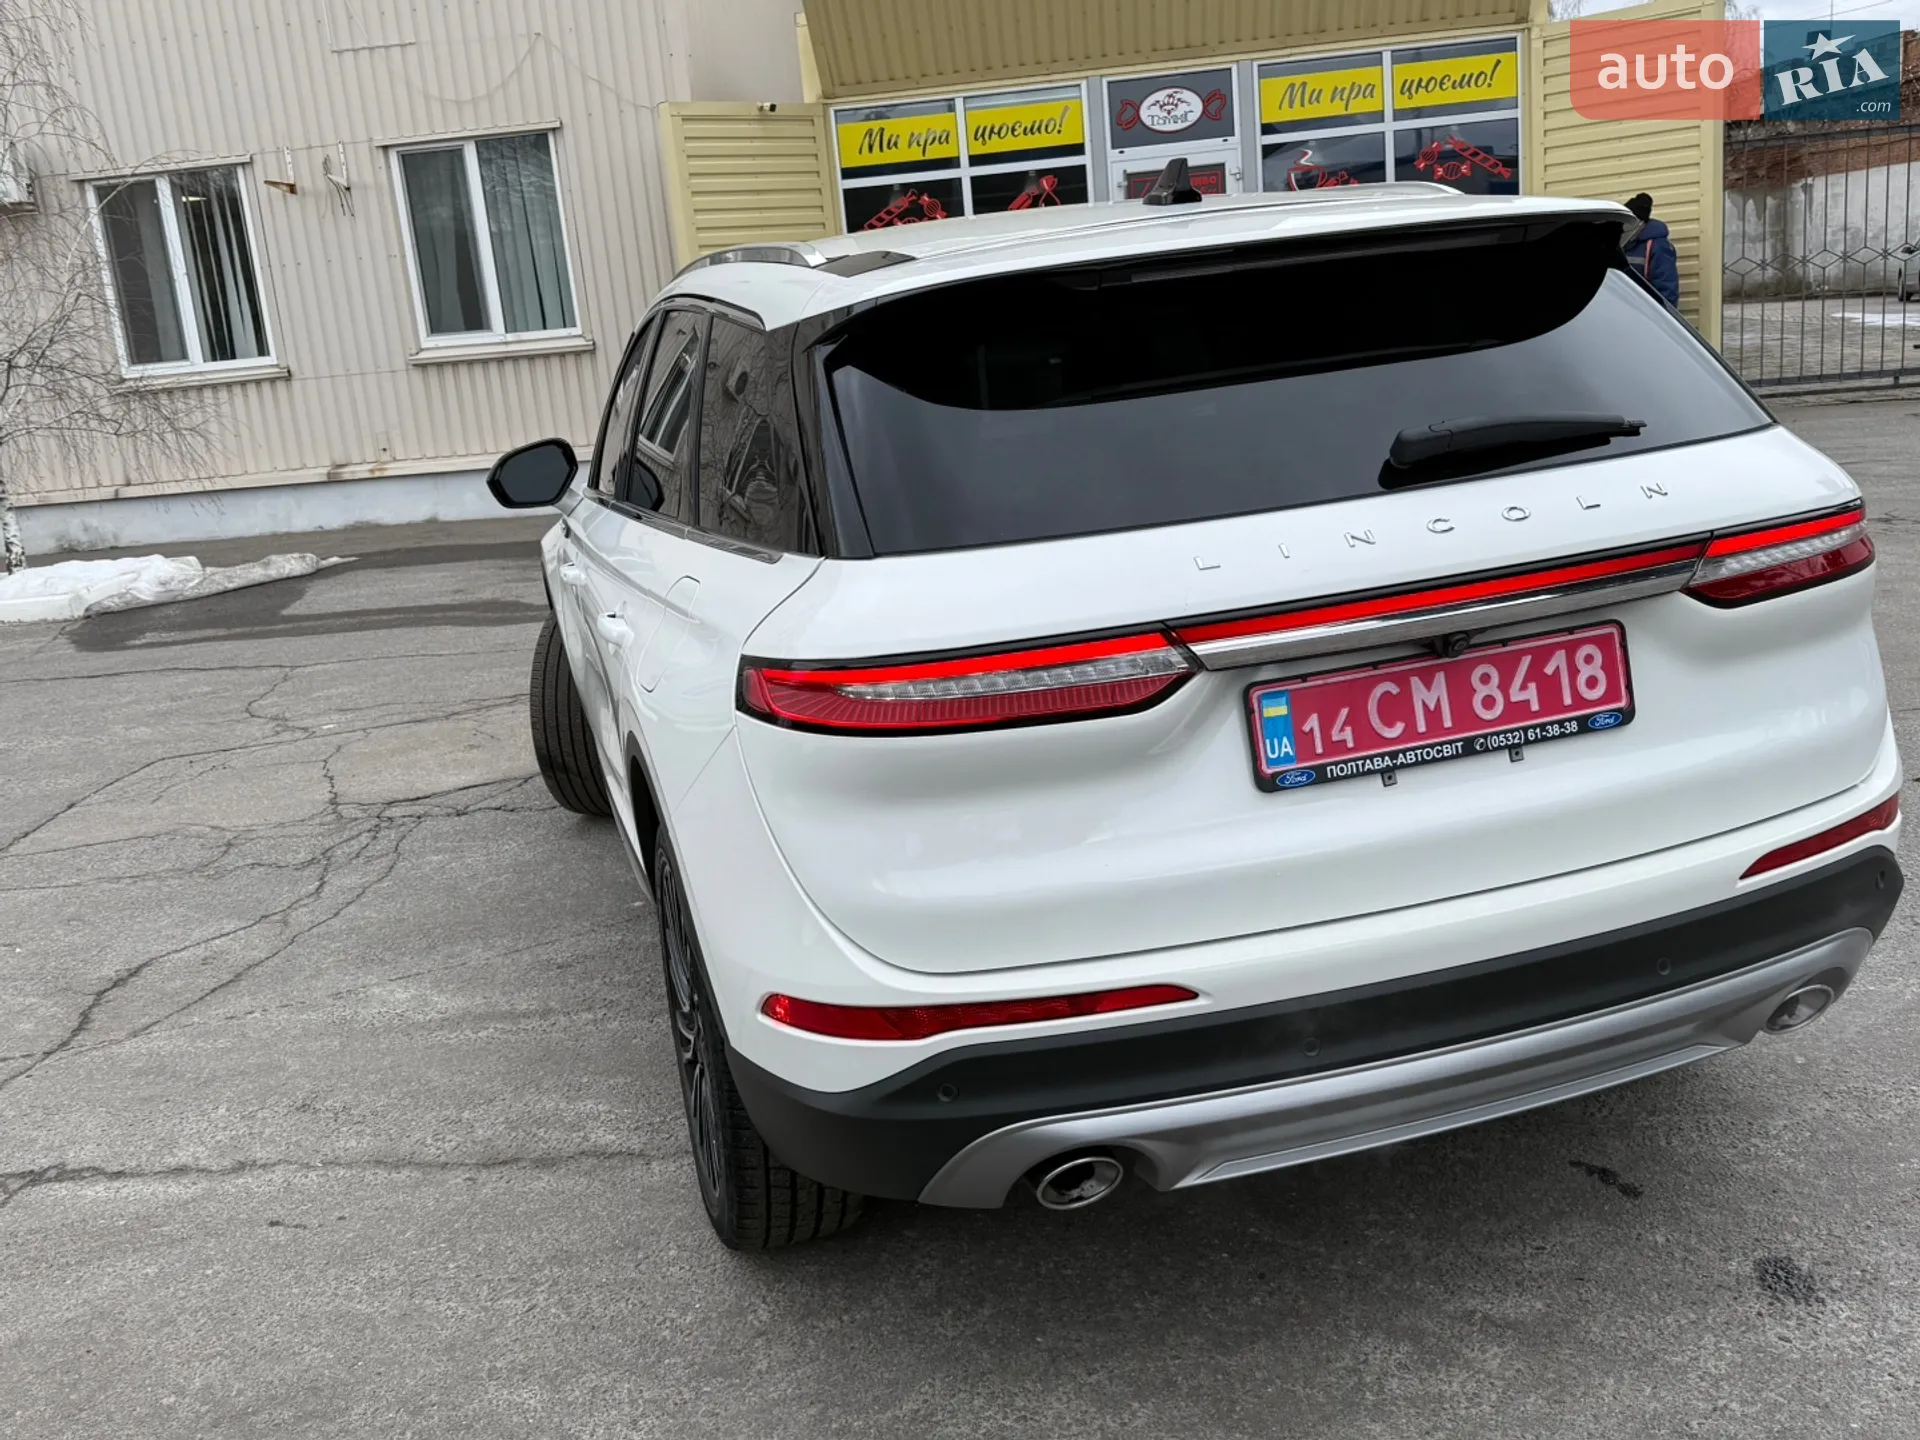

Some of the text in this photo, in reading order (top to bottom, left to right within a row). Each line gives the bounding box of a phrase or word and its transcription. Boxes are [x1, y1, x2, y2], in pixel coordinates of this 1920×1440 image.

[1279, 81, 1323, 111] Ми
[858, 127, 901, 156] Ми
[1194, 481, 1669, 571] LINCOLN
[1471, 644, 1608, 722] 8418
[1266, 735, 1294, 760] UA
[1326, 721, 1579, 778] ПОЛТАВА-АВТОСВІТ (0532) 61-38-38
